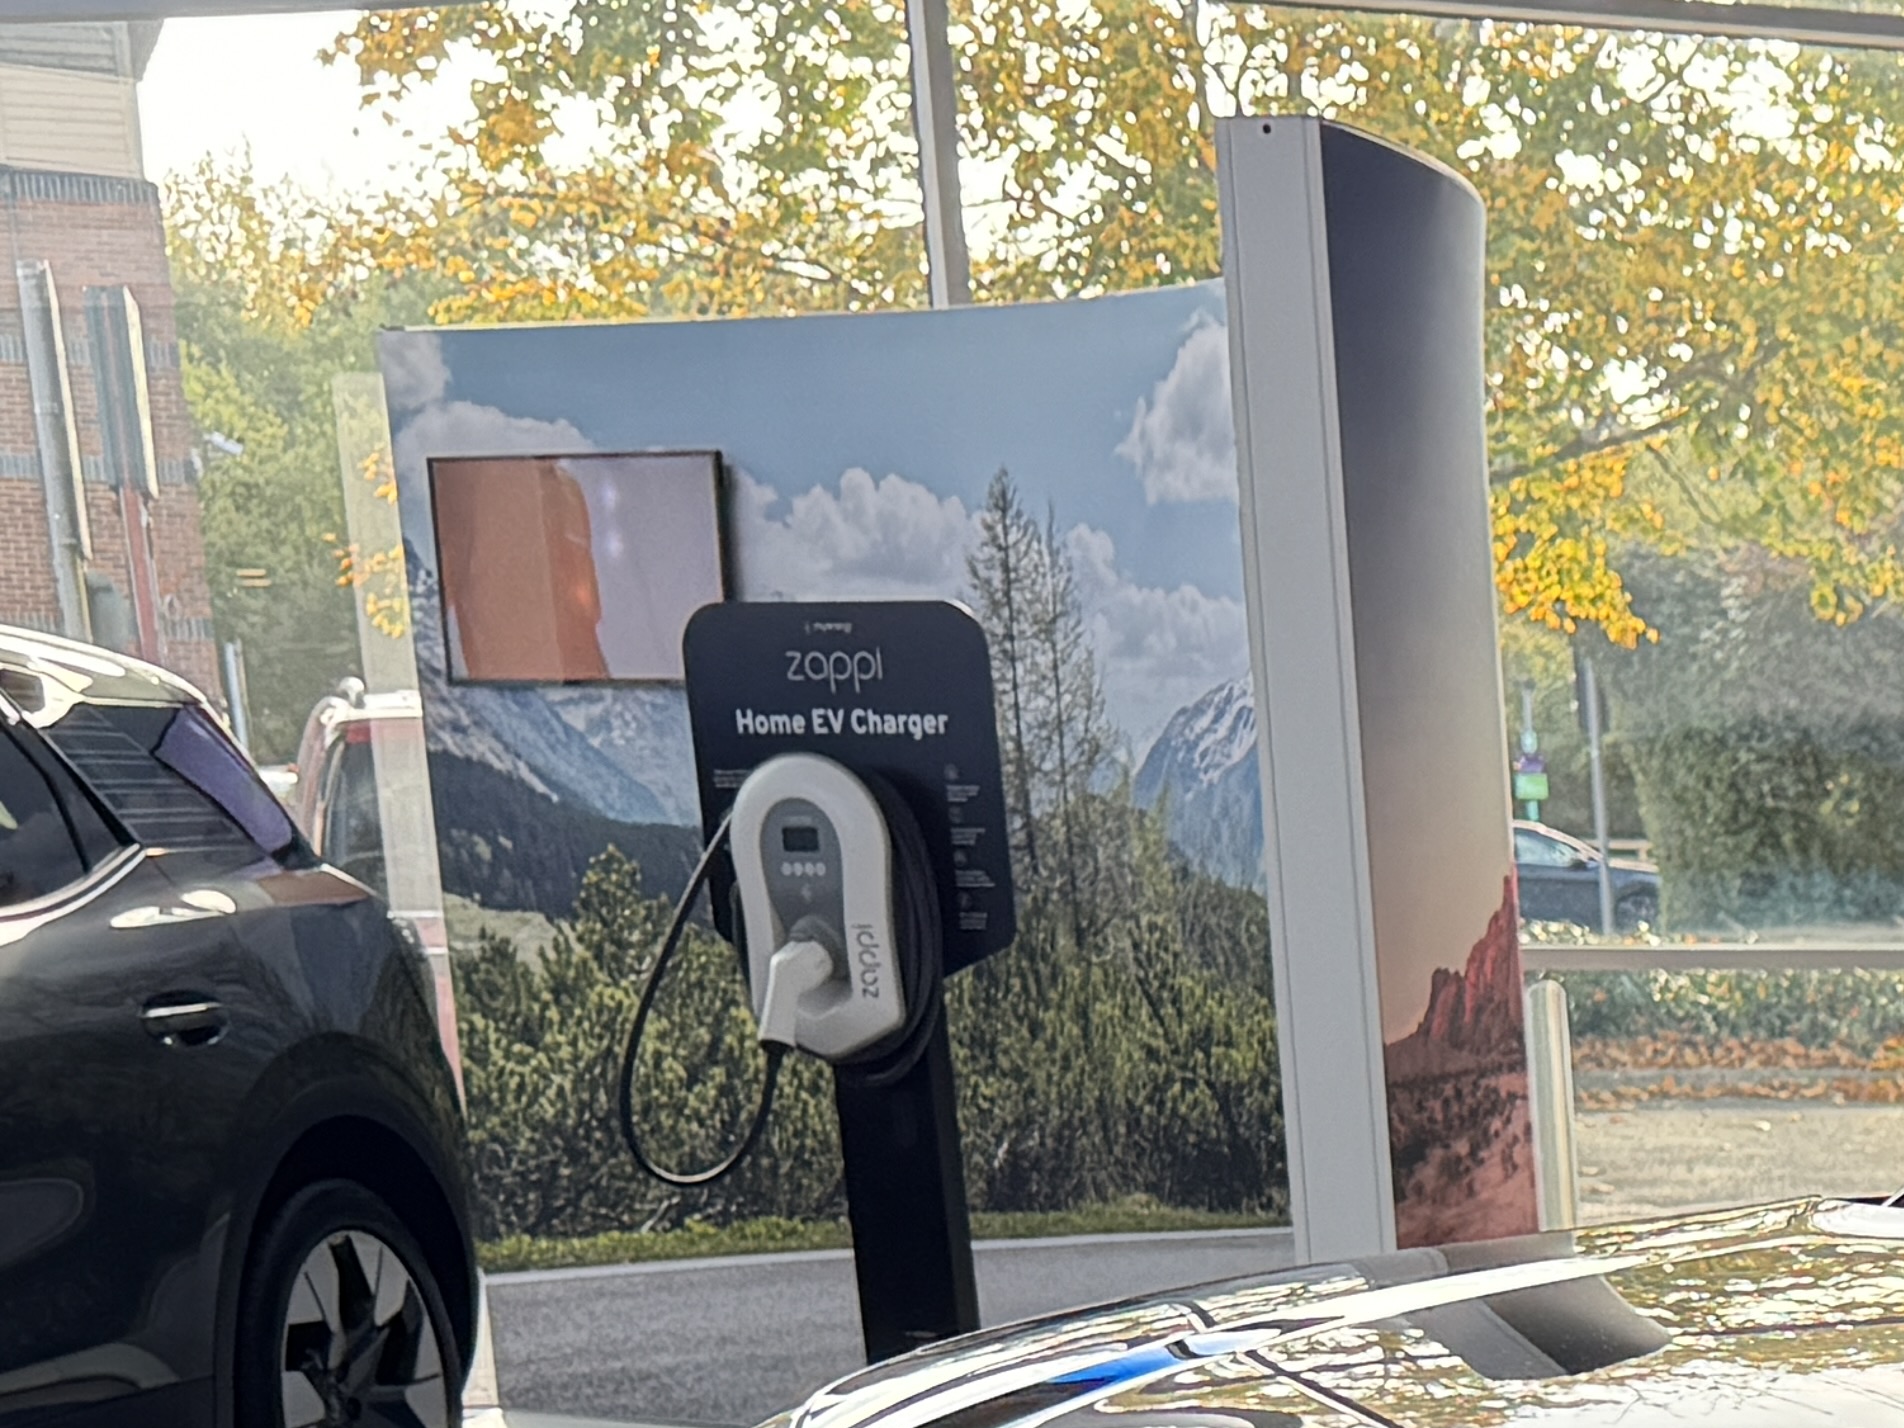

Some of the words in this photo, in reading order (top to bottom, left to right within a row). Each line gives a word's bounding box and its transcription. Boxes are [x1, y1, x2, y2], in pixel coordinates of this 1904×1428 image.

[736, 708, 806, 734] Home
[812, 708, 844, 734] EV
[850, 708, 949, 741] Charger
